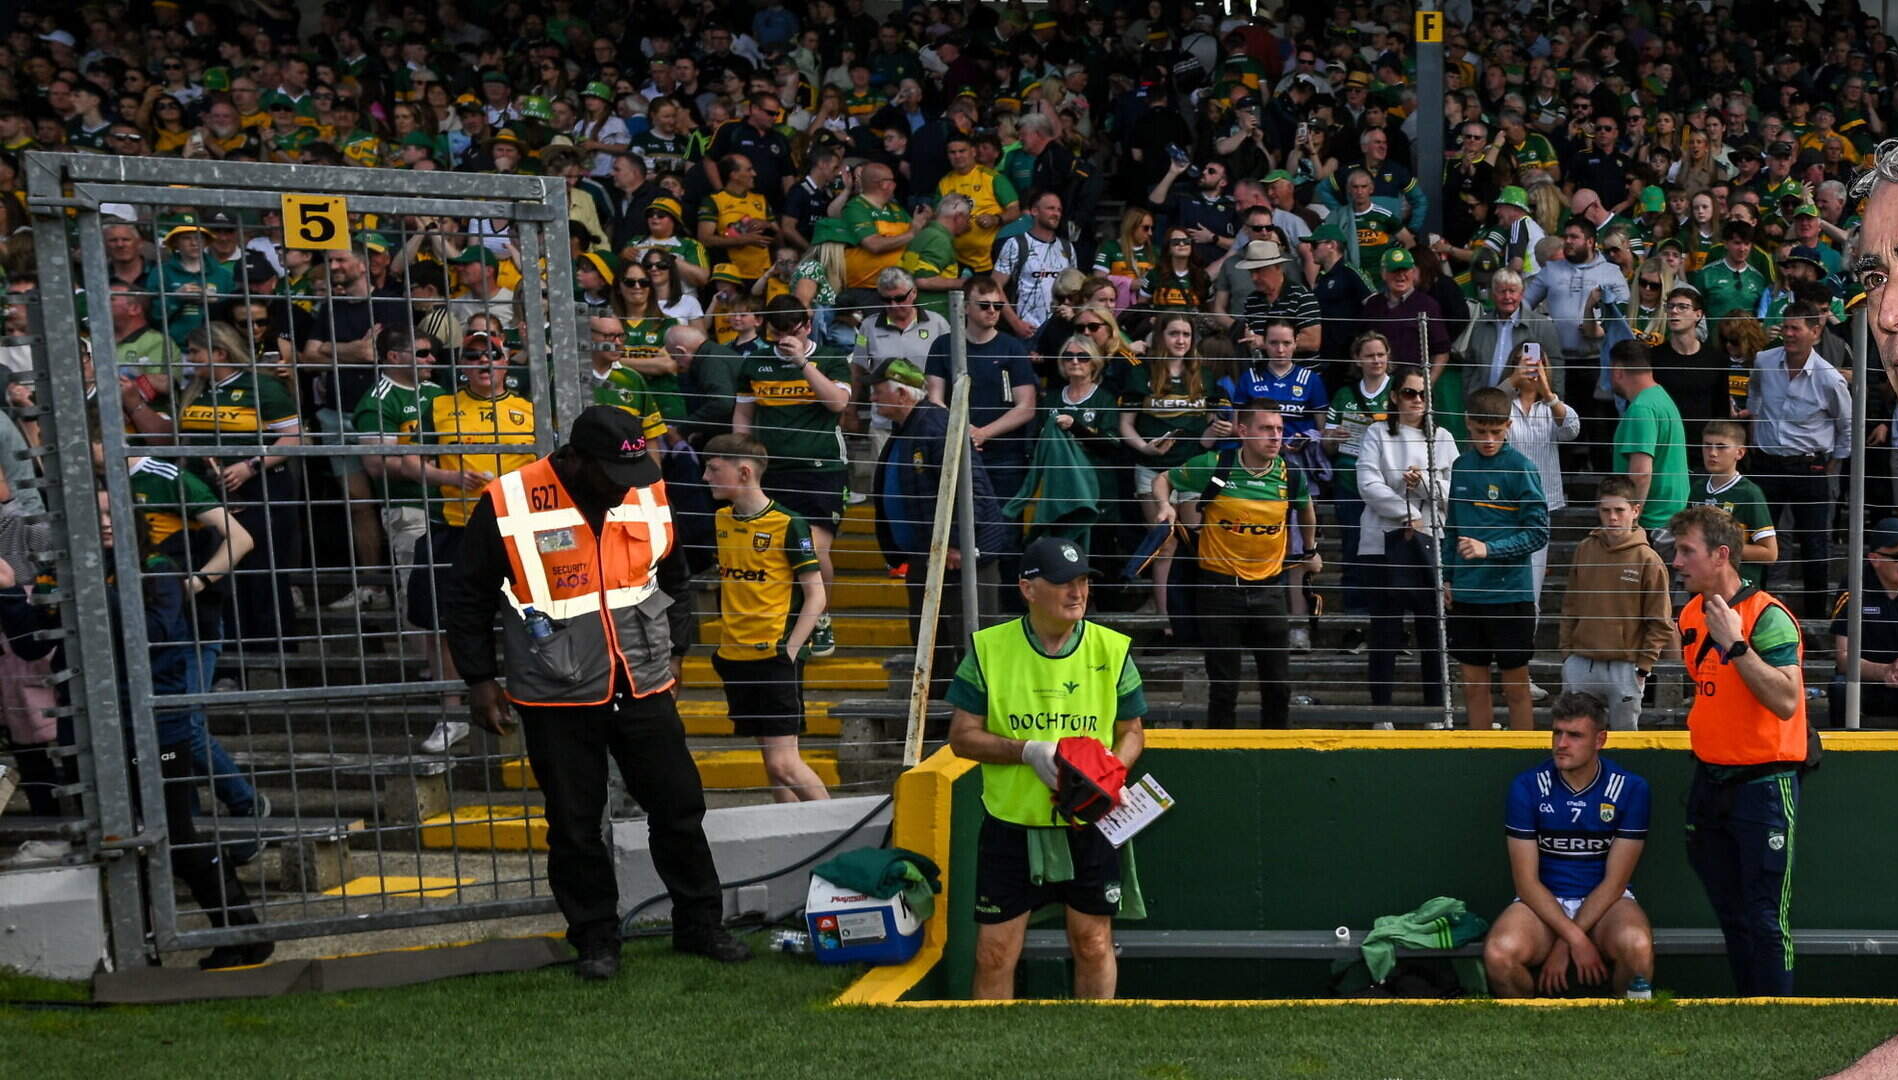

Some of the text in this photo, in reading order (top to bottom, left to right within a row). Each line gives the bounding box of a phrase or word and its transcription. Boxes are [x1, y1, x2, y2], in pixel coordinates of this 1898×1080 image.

[1422, 14, 1437, 40] F
[299, 202, 337, 242] 5
[531, 485, 559, 510] 627
[552, 562, 589, 577] SECURITY
[554, 574, 590, 590] AOS
[1570, 808, 1582, 824] 7
[1539, 834, 1615, 852] KERRY
